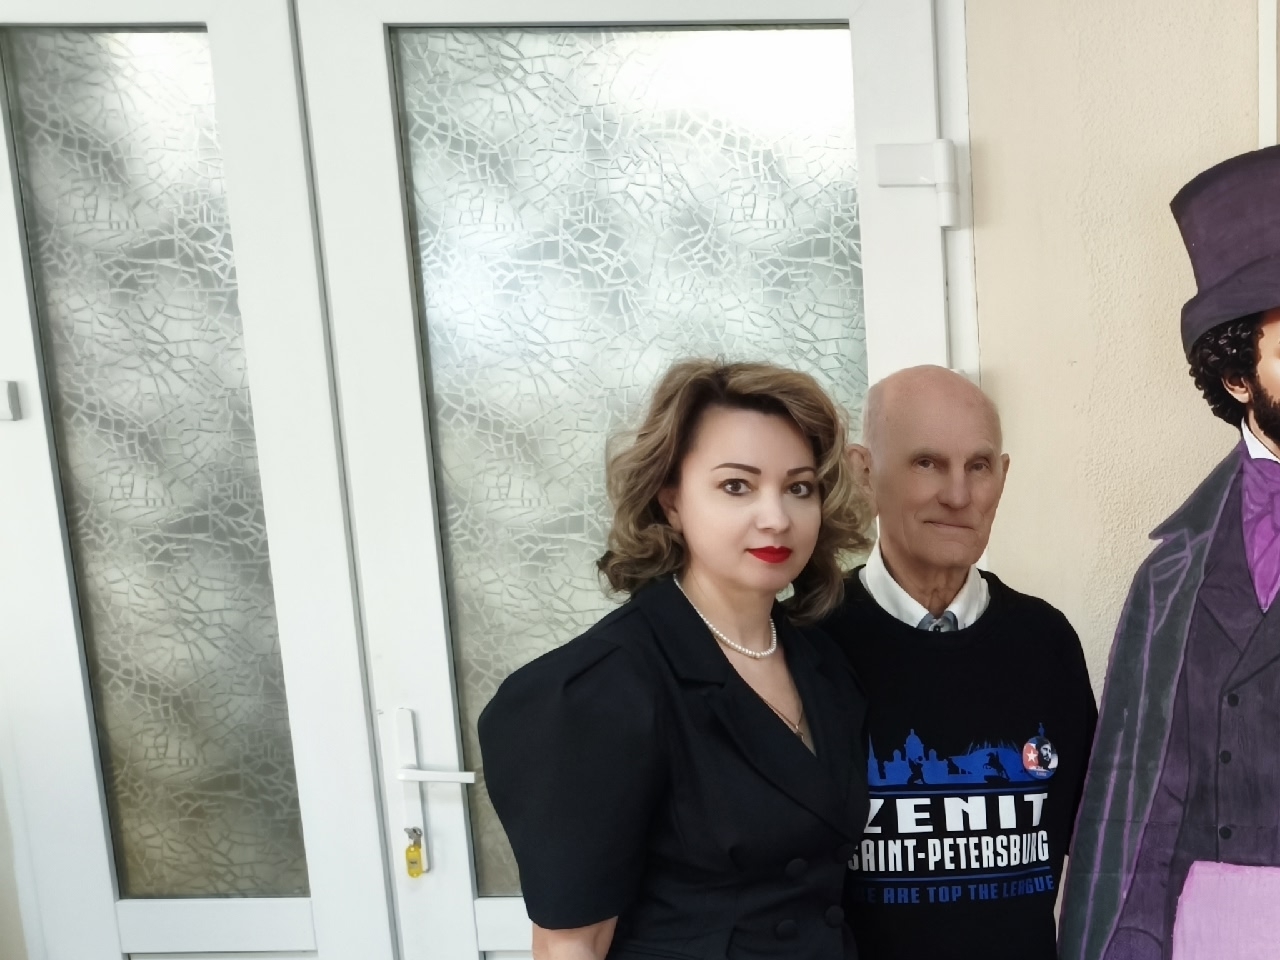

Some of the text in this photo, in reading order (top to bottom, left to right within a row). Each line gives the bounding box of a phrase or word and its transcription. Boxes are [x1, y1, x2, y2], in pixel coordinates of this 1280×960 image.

[864, 793, 1048, 833] ZENIT
[848, 830, 1050, 872] SAINT-PETERSBURG
[884, 887, 920, 904] ARE
[928, 885, 963, 903] TOP
[968, 883, 998, 900] THE
[1002, 874, 1055, 898] LEAGUE
